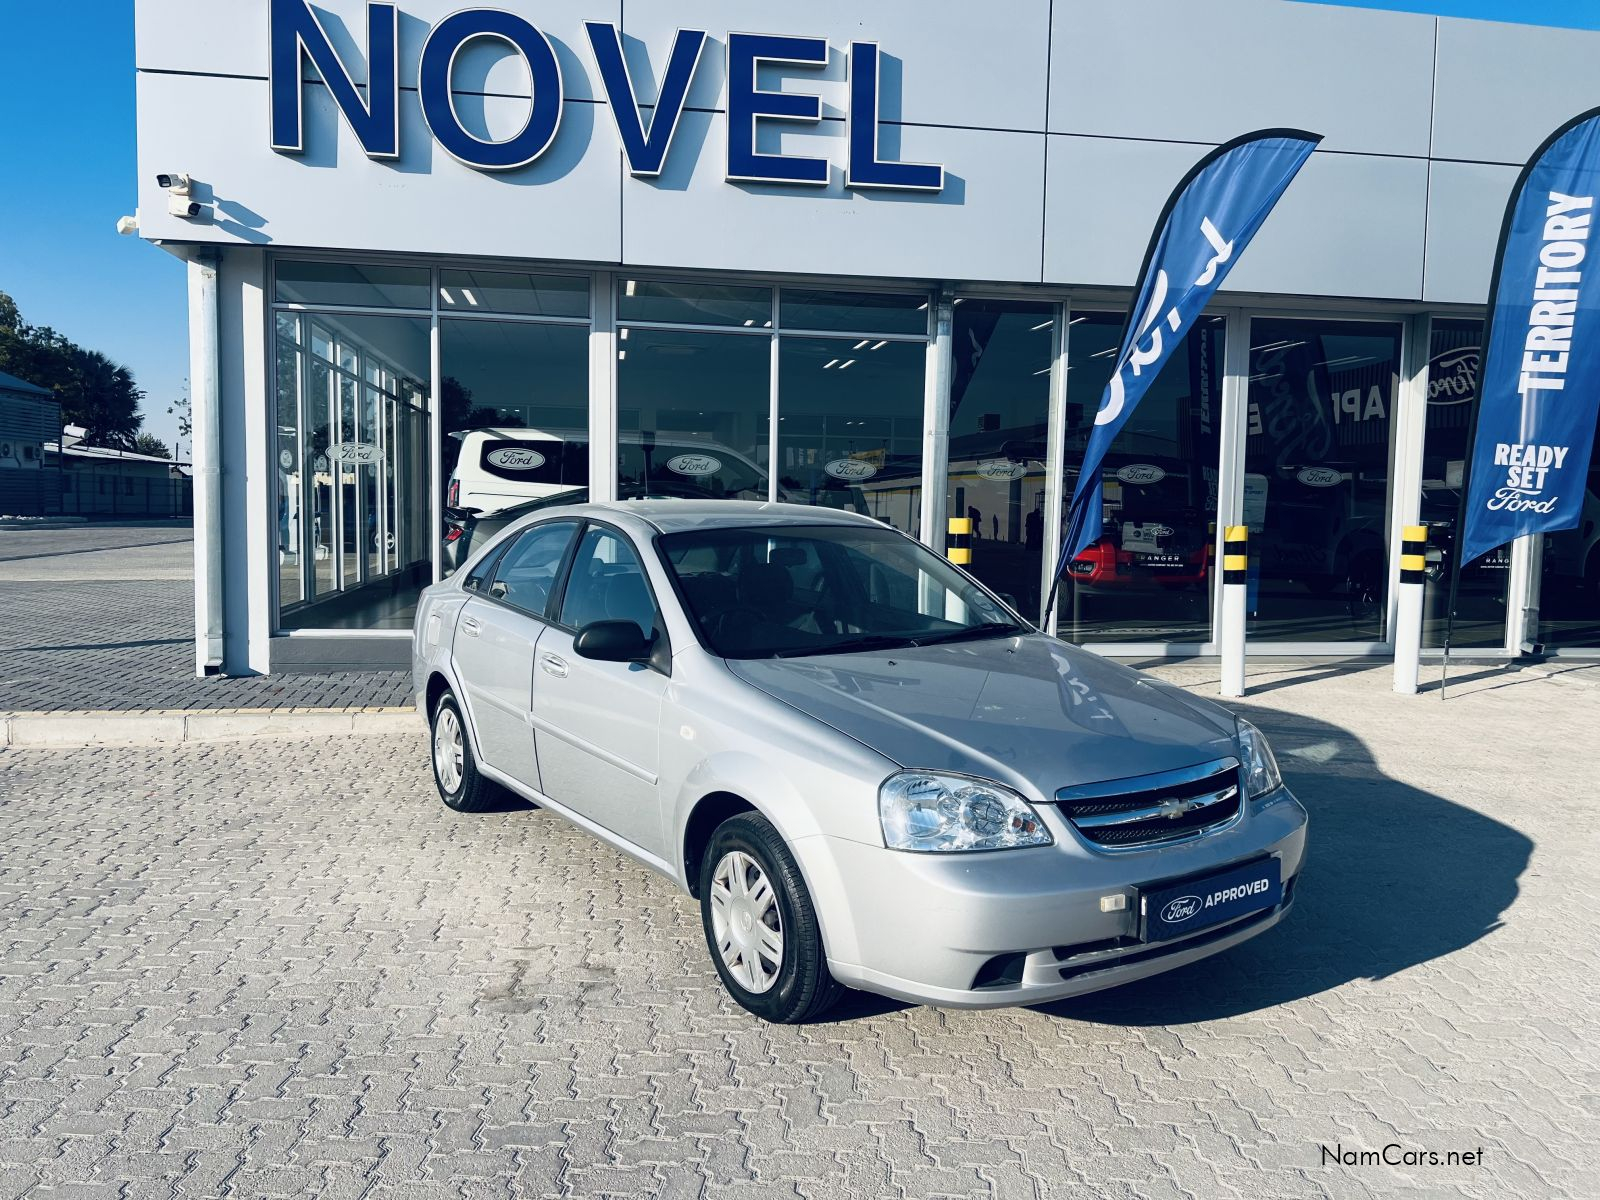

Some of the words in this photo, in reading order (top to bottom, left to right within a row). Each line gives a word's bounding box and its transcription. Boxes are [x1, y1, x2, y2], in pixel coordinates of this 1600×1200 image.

[268, 0, 945, 191] NOVEL
[1517, 190, 1594, 395] TERRITORY
[1493, 443, 1569, 469] READY
[1506, 466, 1549, 490] SET
[1486, 487, 1557, 514] Ford
[1204, 878, 1270, 908] APPROVED
